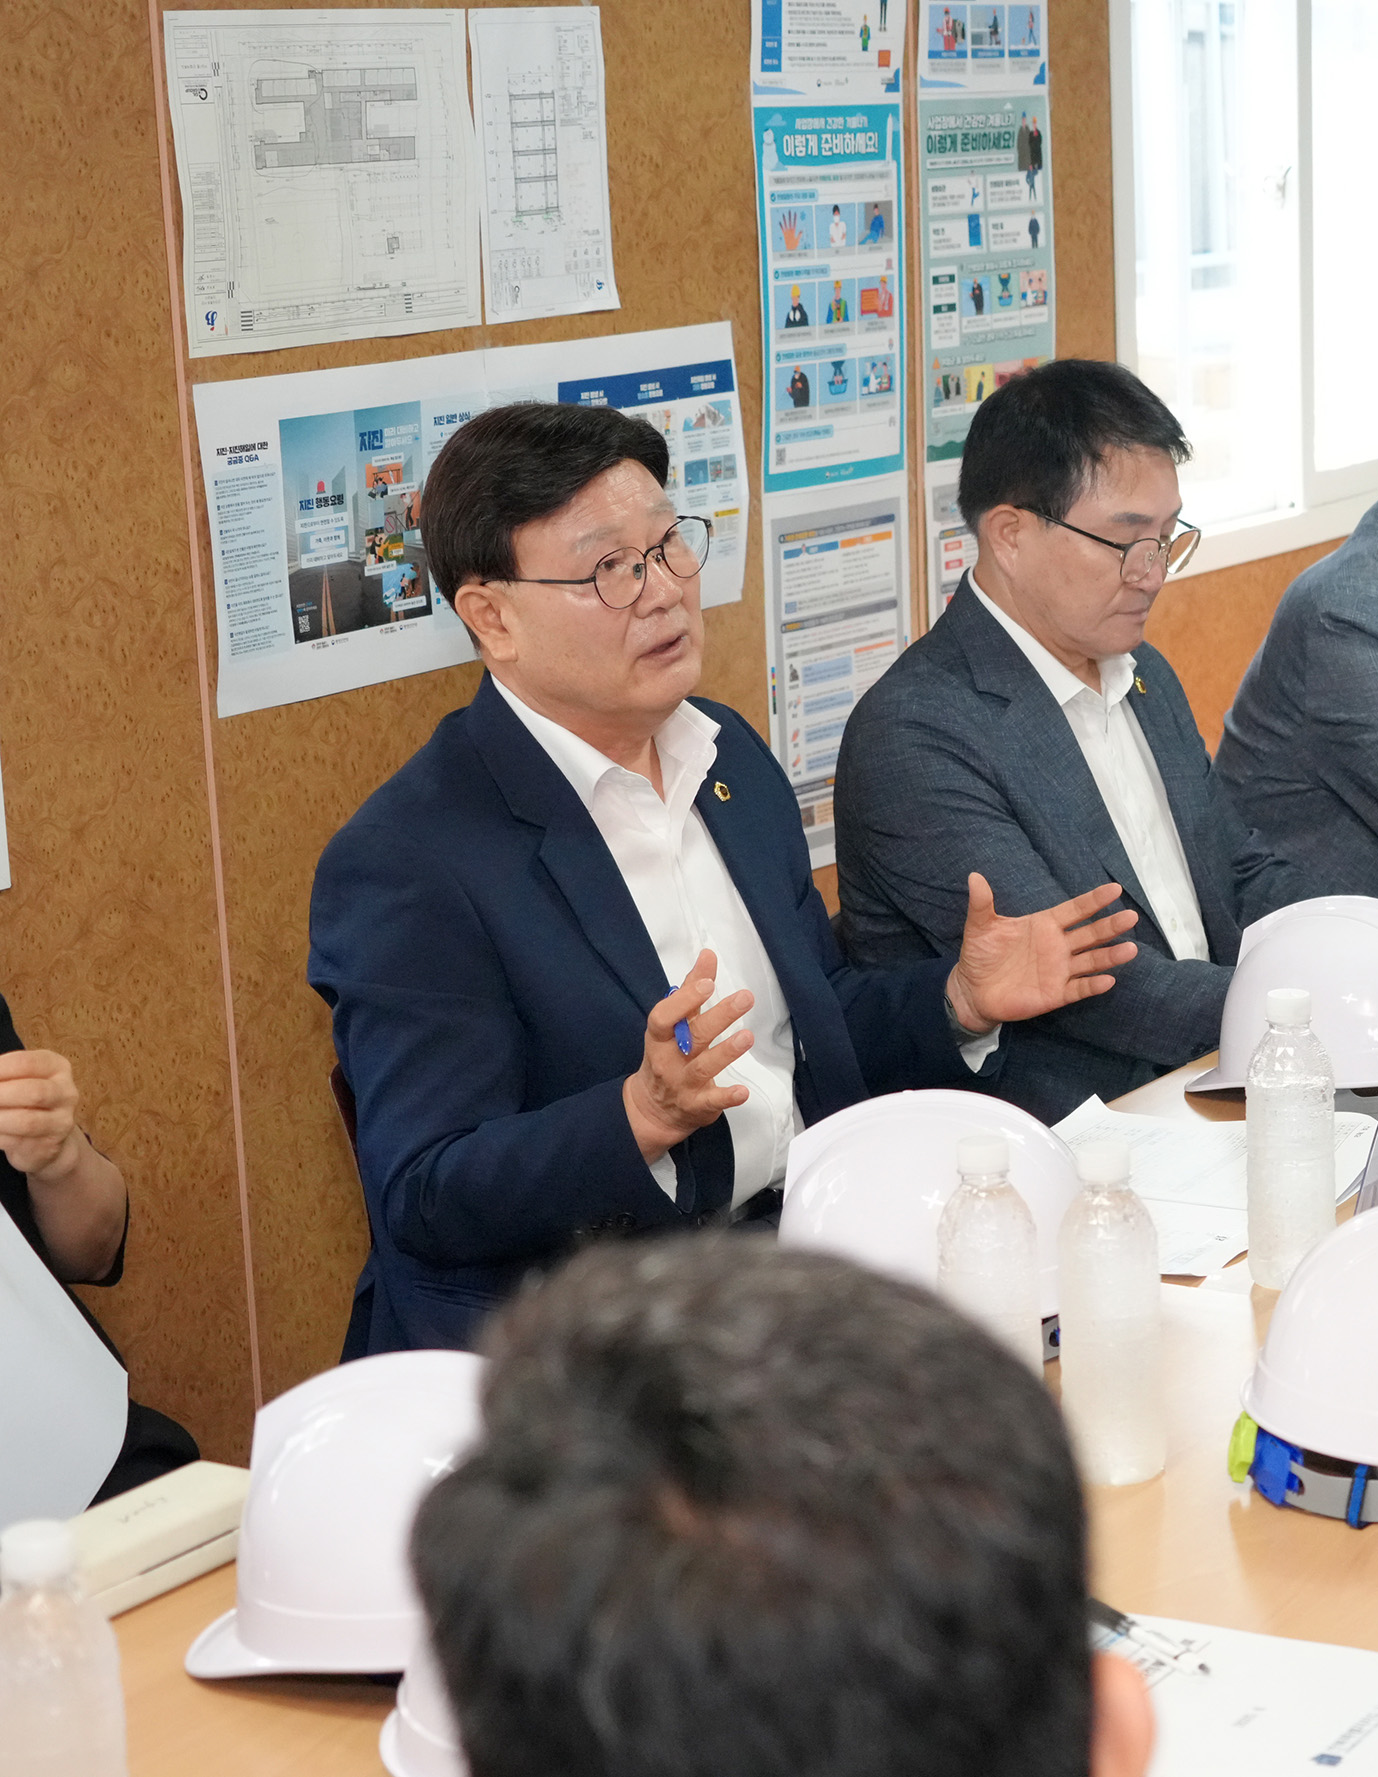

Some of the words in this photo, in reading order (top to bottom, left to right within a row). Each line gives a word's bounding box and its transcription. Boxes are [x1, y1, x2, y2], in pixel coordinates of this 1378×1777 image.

[826, 116, 845, 130] 건강한
[927, 115, 962, 130] 사업장에서
[964, 114, 987, 129] 건강한
[783, 133, 819, 157] 이렇게
[821, 131, 879, 156] 준비하세요!
[926, 133, 958, 154] 이렇게
[961, 130, 1015, 152] 준비하세요!
[433, 416, 445, 426] 지진
[446, 414, 458, 425] 일반
[458, 411, 471, 423] 상식
[256, 441, 268, 451] 대한
[359, 429, 383, 452] 지진
[244, 454, 259, 463] Q&A
[299, 498, 314, 511] 지진
[315, 493, 344, 509] 행동요령
